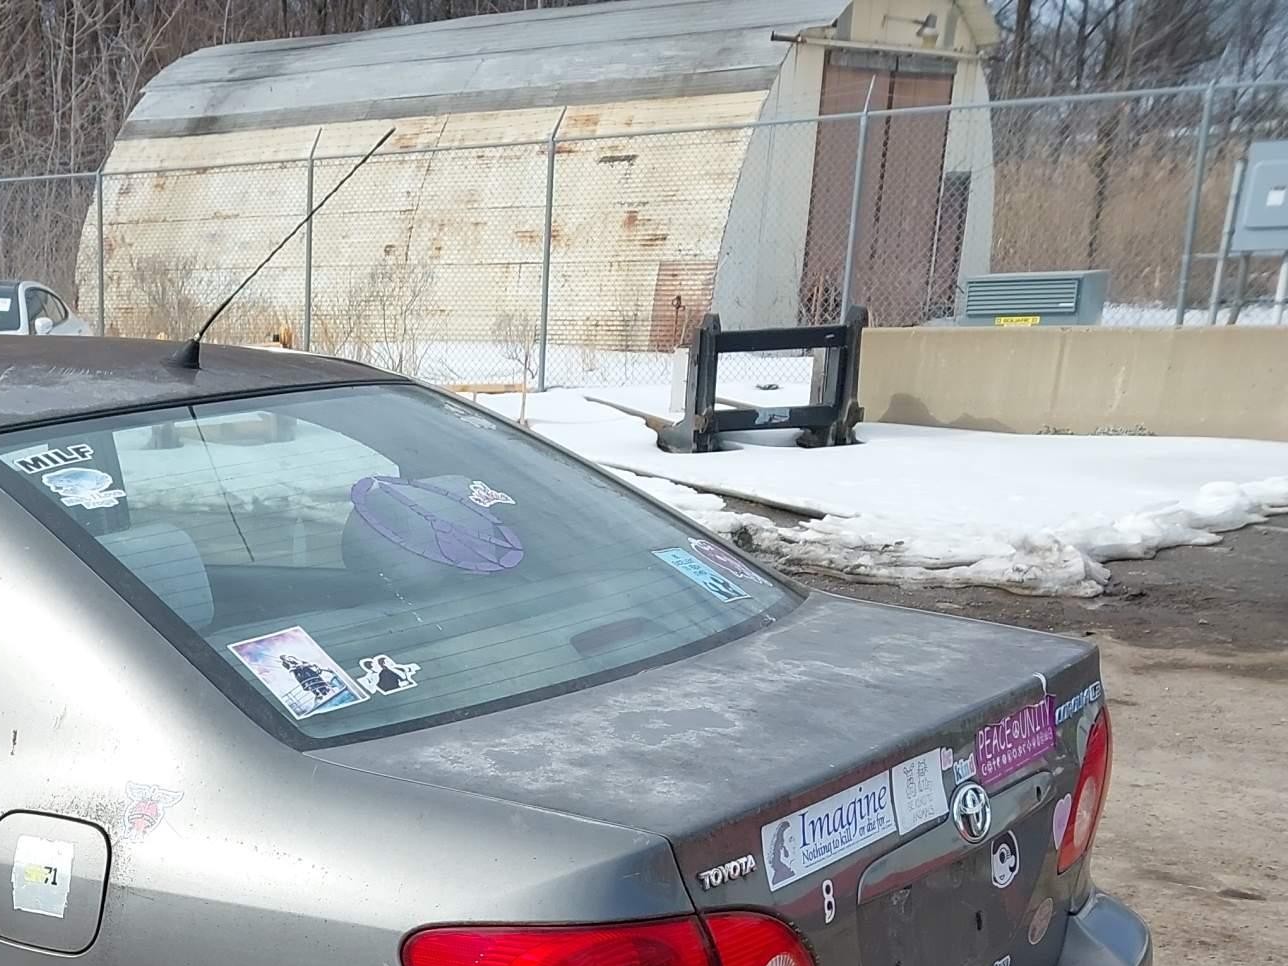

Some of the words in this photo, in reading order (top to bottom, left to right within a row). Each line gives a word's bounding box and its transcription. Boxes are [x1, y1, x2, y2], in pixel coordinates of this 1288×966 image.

[16, 446, 91, 473] MILF
[978, 716, 1012, 761] PEACE
[1019, 697, 1050, 739] UNITY
[798, 786, 887, 849] Imagine
[802, 842, 833, 865] Nothing
[833, 836, 840, 850] to
[839, 828, 853, 846] kill
[698, 854, 758, 890] TOYOTA
